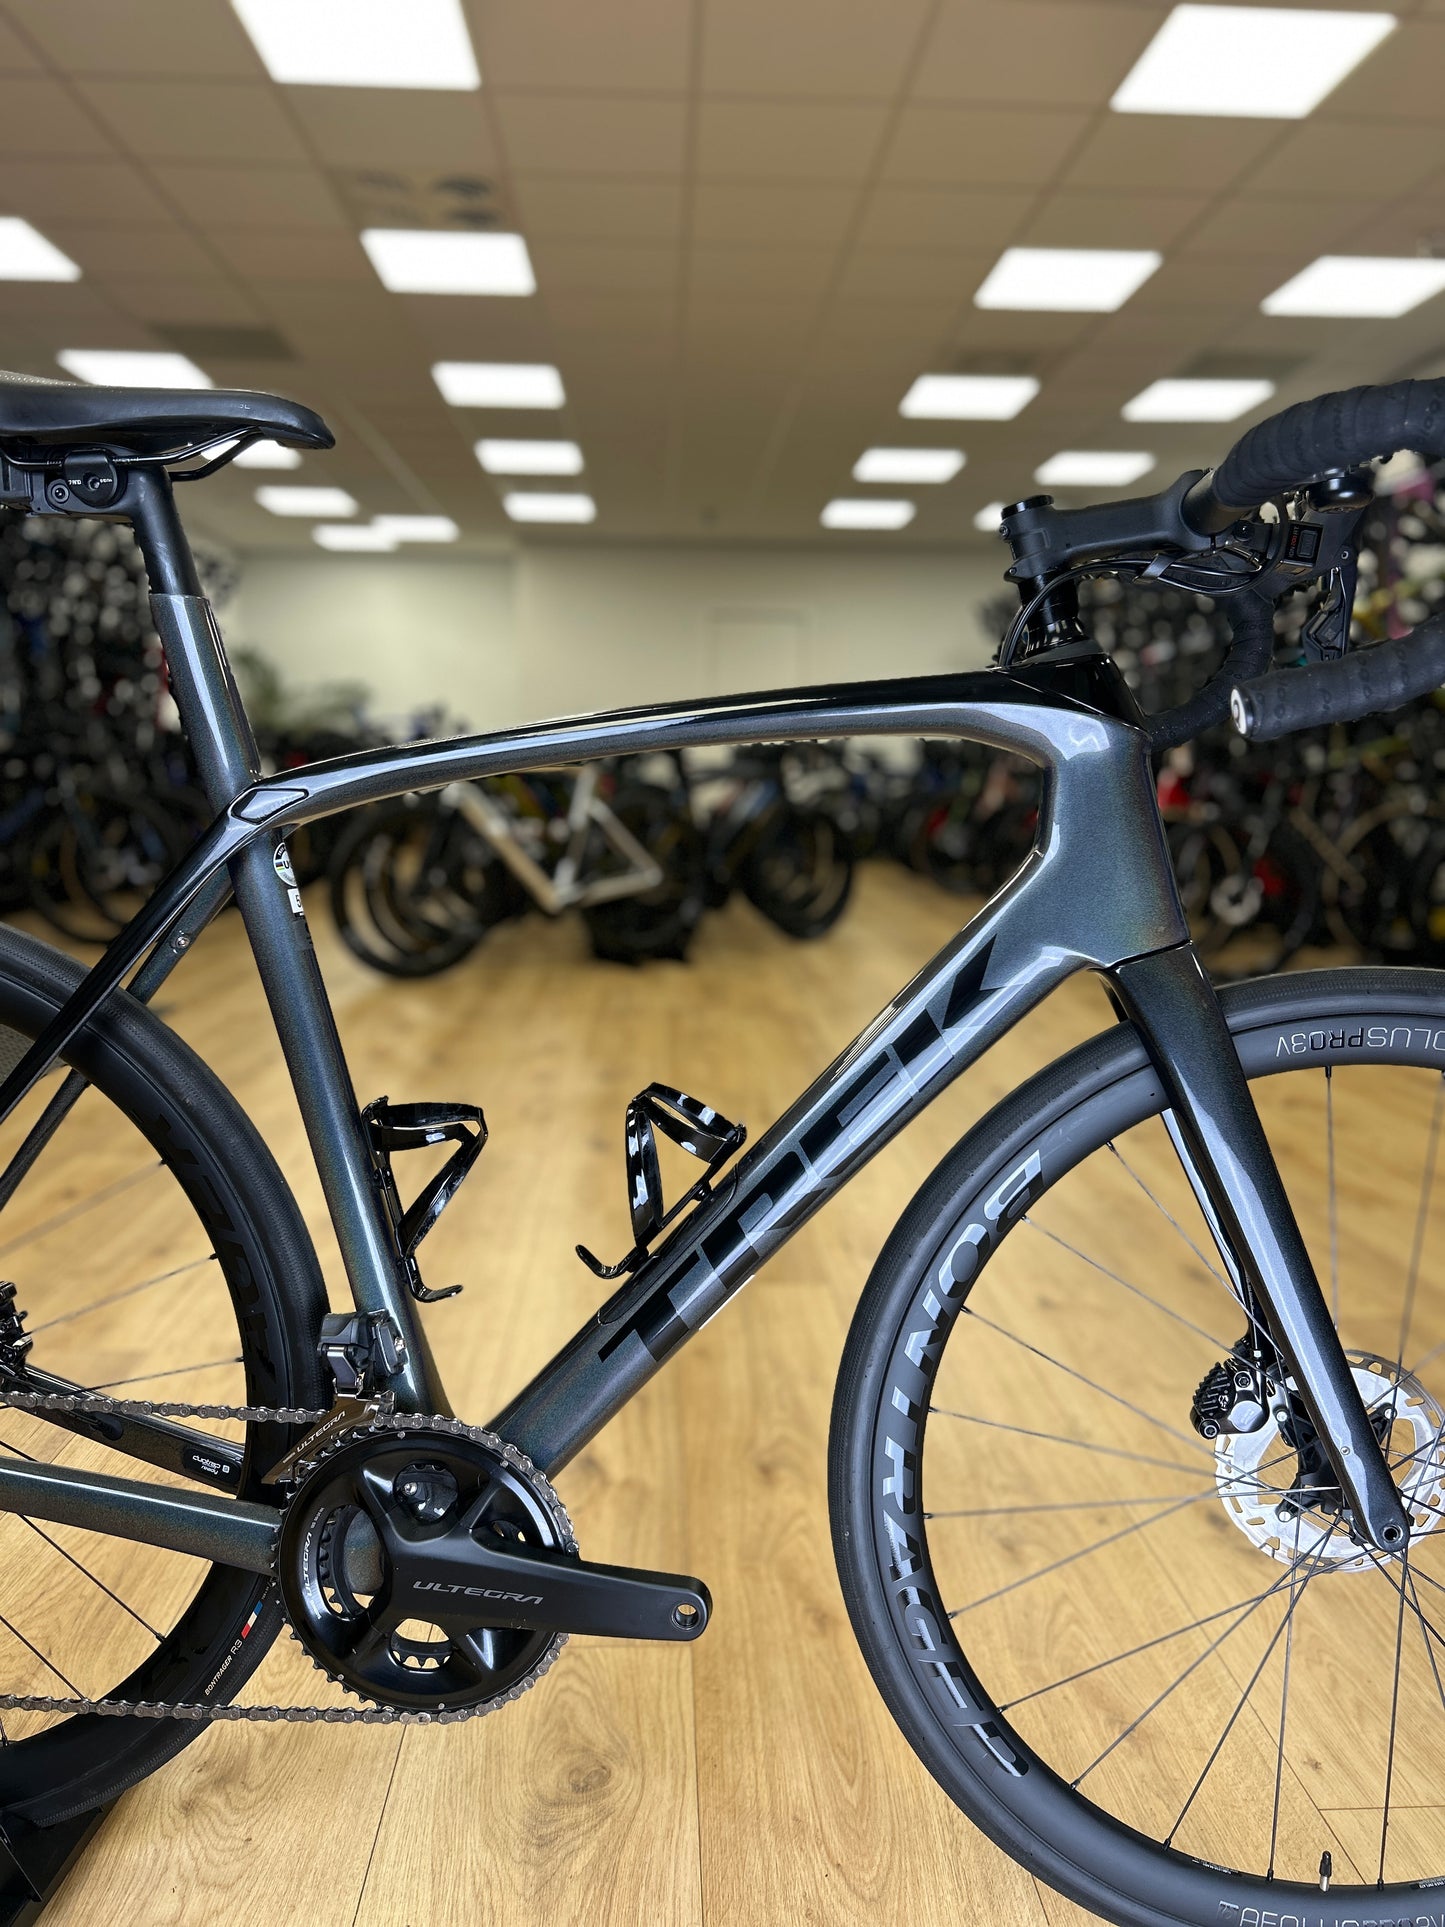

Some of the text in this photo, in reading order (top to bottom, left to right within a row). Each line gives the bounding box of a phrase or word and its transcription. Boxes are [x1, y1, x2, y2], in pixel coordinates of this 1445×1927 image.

[597, 933, 1030, 1363] TREK
[296, 1410, 346, 1453] ULTEGRA
[302, 1532, 313, 1597] ULTEGRA
[412, 1580, 544, 1605] ULTEGRA
[204, 1638, 244, 1696] BONTRAGER R3
